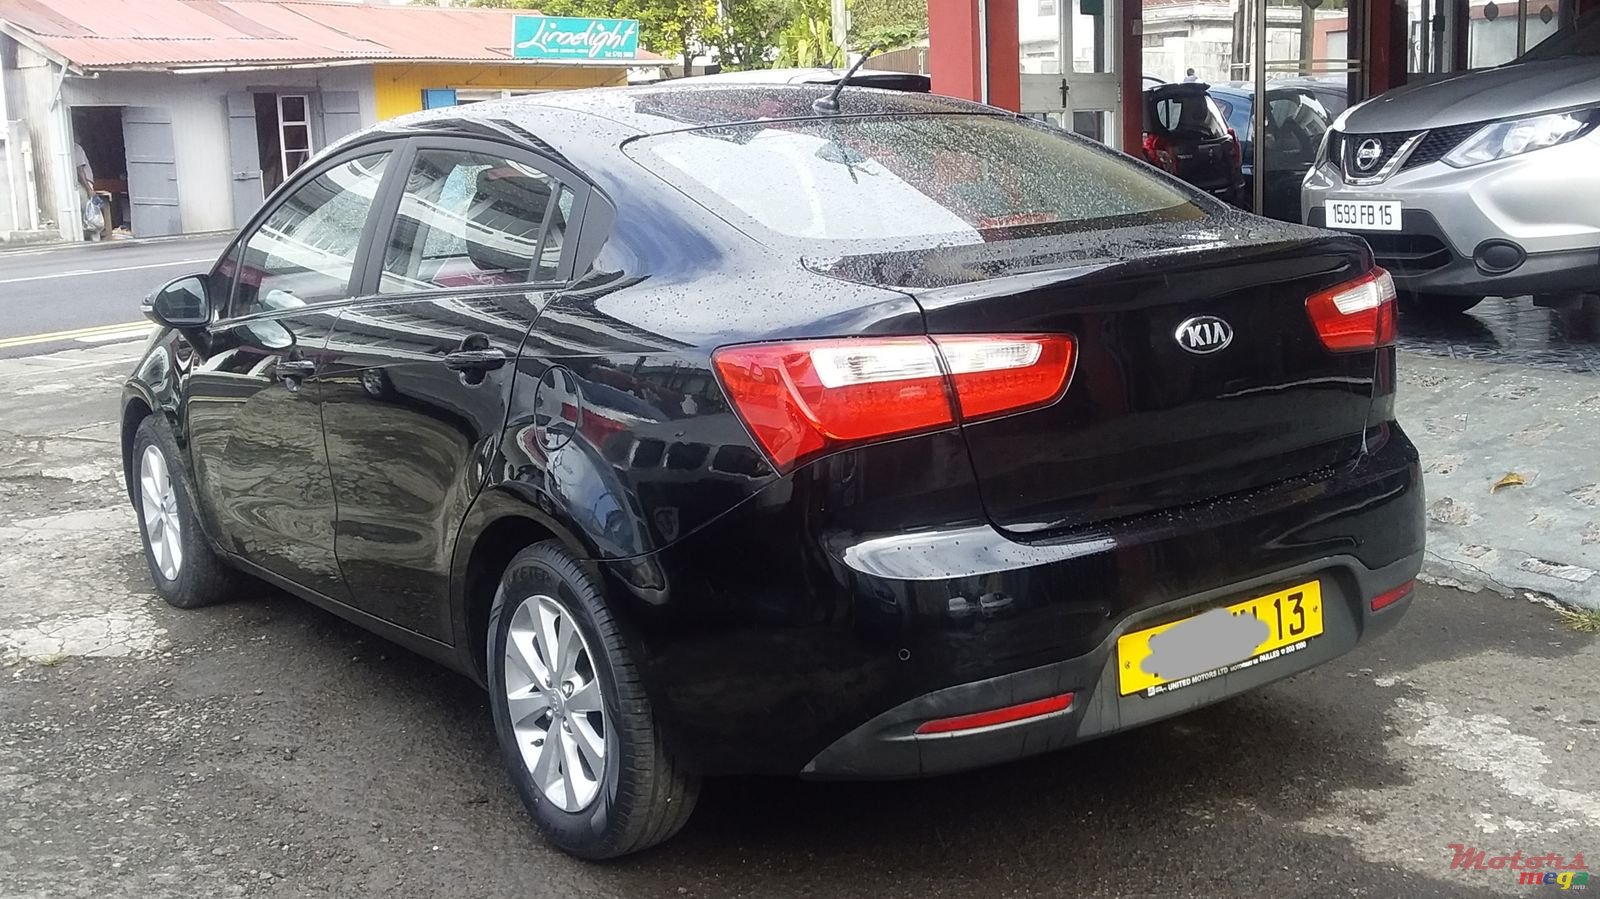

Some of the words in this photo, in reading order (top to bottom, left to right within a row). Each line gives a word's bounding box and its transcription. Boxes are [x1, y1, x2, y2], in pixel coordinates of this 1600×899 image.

[1333, 204, 1357, 224] 1593
[1360, 205, 1375, 225] FB
[1379, 205, 1392, 225] 15
[1187, 322, 1226, 347] KIA
[1273, 592, 1305, 640] 13
[1168, 679, 1191, 691] UNITED
[1191, 670, 1217, 684] MOTORS
[1217, 666, 1229, 676] LTD
